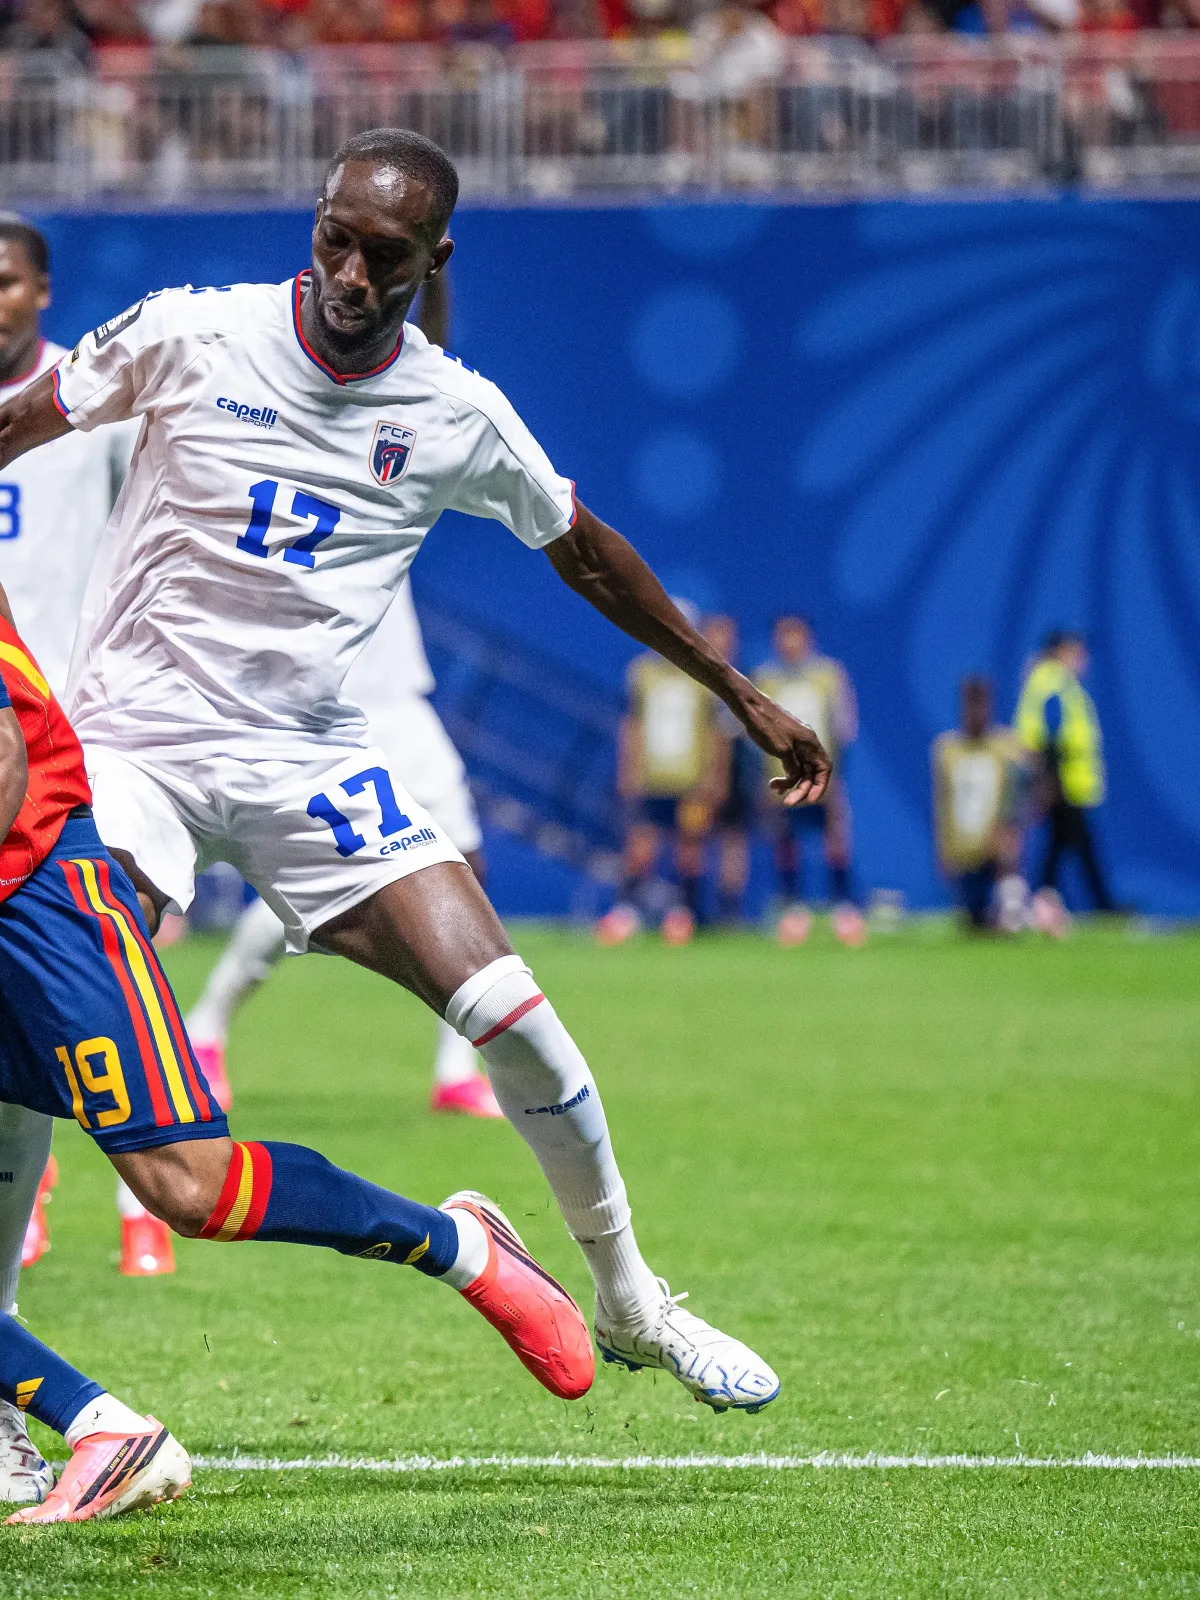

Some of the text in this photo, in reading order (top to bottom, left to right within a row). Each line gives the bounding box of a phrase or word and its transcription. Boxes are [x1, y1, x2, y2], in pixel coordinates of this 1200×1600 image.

[216, 397, 278, 425] capelli
[241, 416, 274, 430] SPORT
[380, 425, 414, 439] FCF
[236, 479, 340, 568] 17
[306, 766, 412, 857] 17
[379, 828, 436, 855] capelli
[55, 1036, 131, 1128] 19
